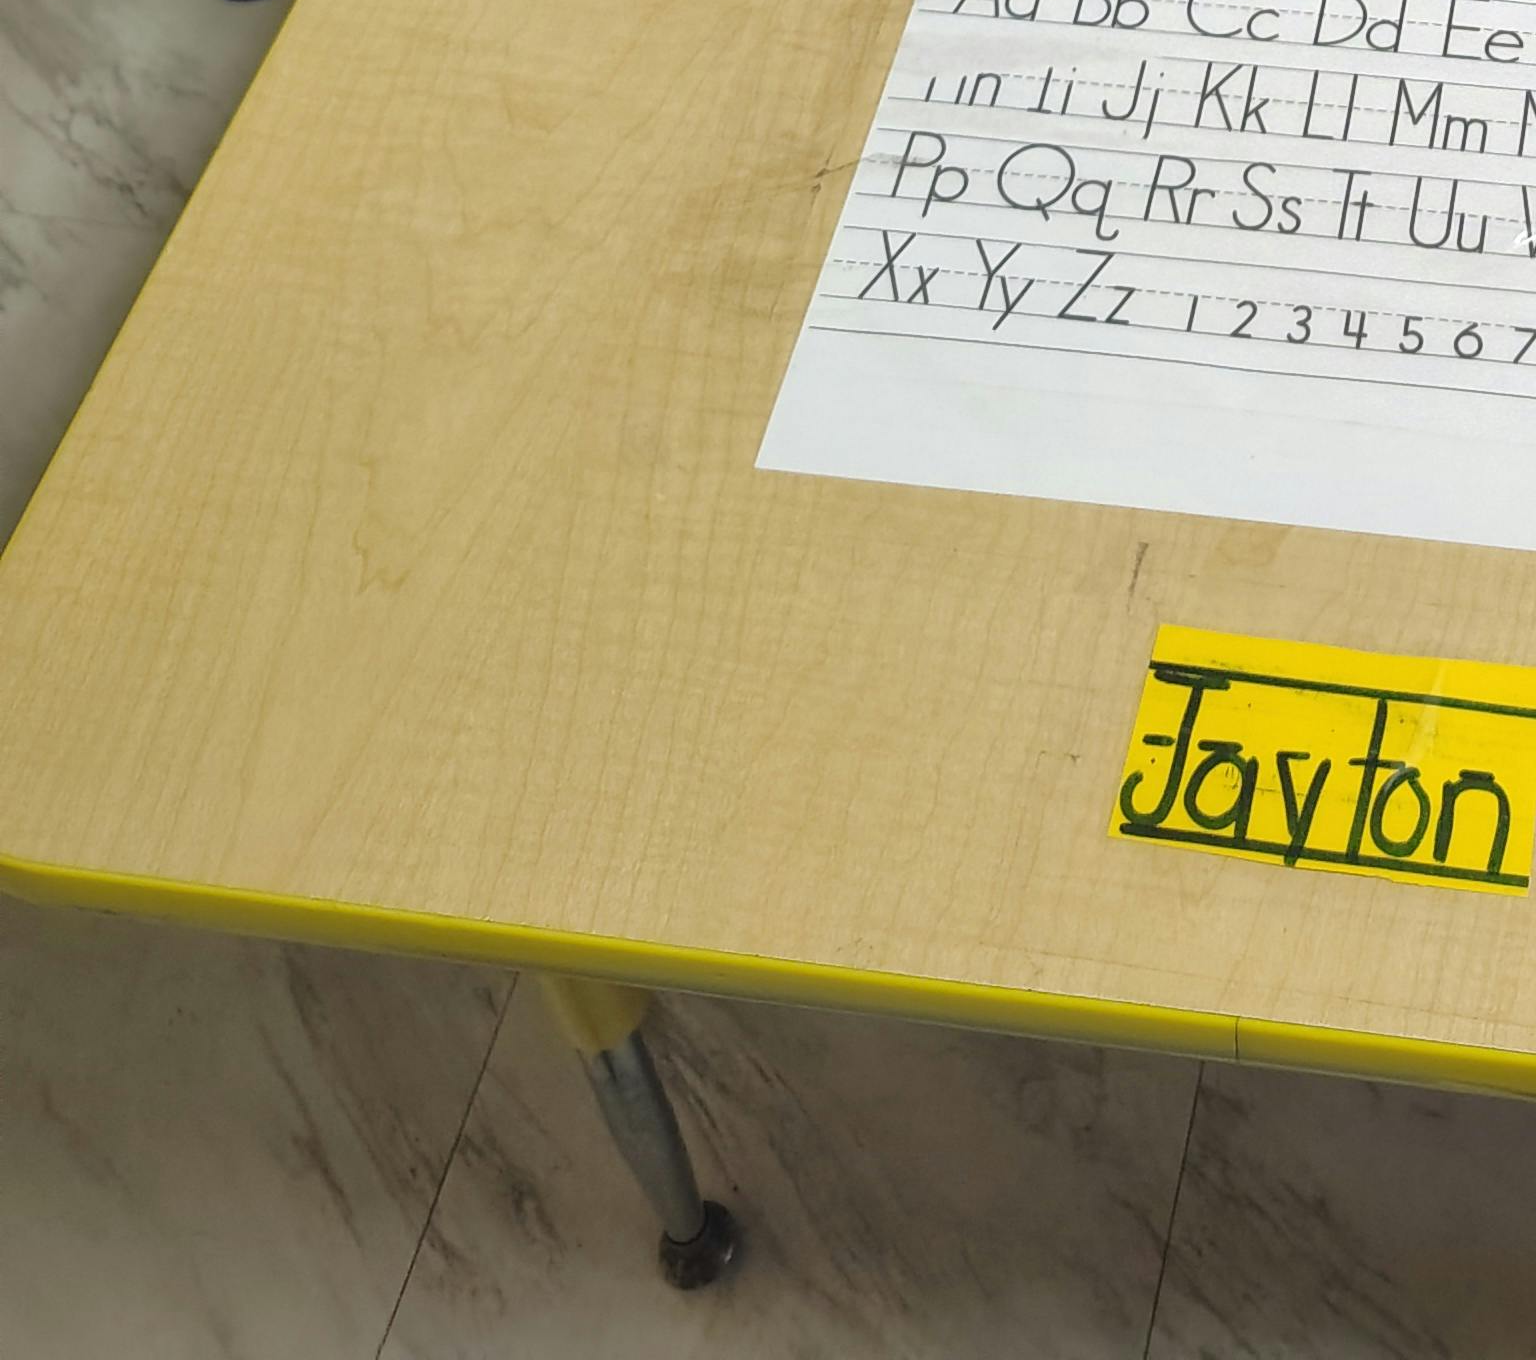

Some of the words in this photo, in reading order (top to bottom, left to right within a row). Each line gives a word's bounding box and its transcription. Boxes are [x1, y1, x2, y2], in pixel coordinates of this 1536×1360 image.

[1101, 60, 1166, 140] Jj
[1195, 61, 1270, 135] Kk
[1302, 69, 1354, 143] Ll
[1389, 79, 1489, 156] Mm
[890, 130, 970, 216] Pp
[996, 142, 1120, 242] Qq
[1144, 154, 1215, 226] Rr
[1232, 162, 1303, 236] Ss
[1332, 169, 1376, 242] Tt
[1408, 175, 1488, 255] Uu
[858, 230, 939, 306] Xx
[974, 241, 1034, 332] Yy
[1056, 248, 1131, 328] Zz
[1184, 294, 1197, 332] 1
[1229, 298, 1256, 338] 2
[1285, 304, 1313, 344] 3
[1341, 311, 1369, 349] 4
[1397, 315, 1425, 354] 5
[1452, 320, 1484, 361] 6
[1119, 668, 1511, 877] Jayton
